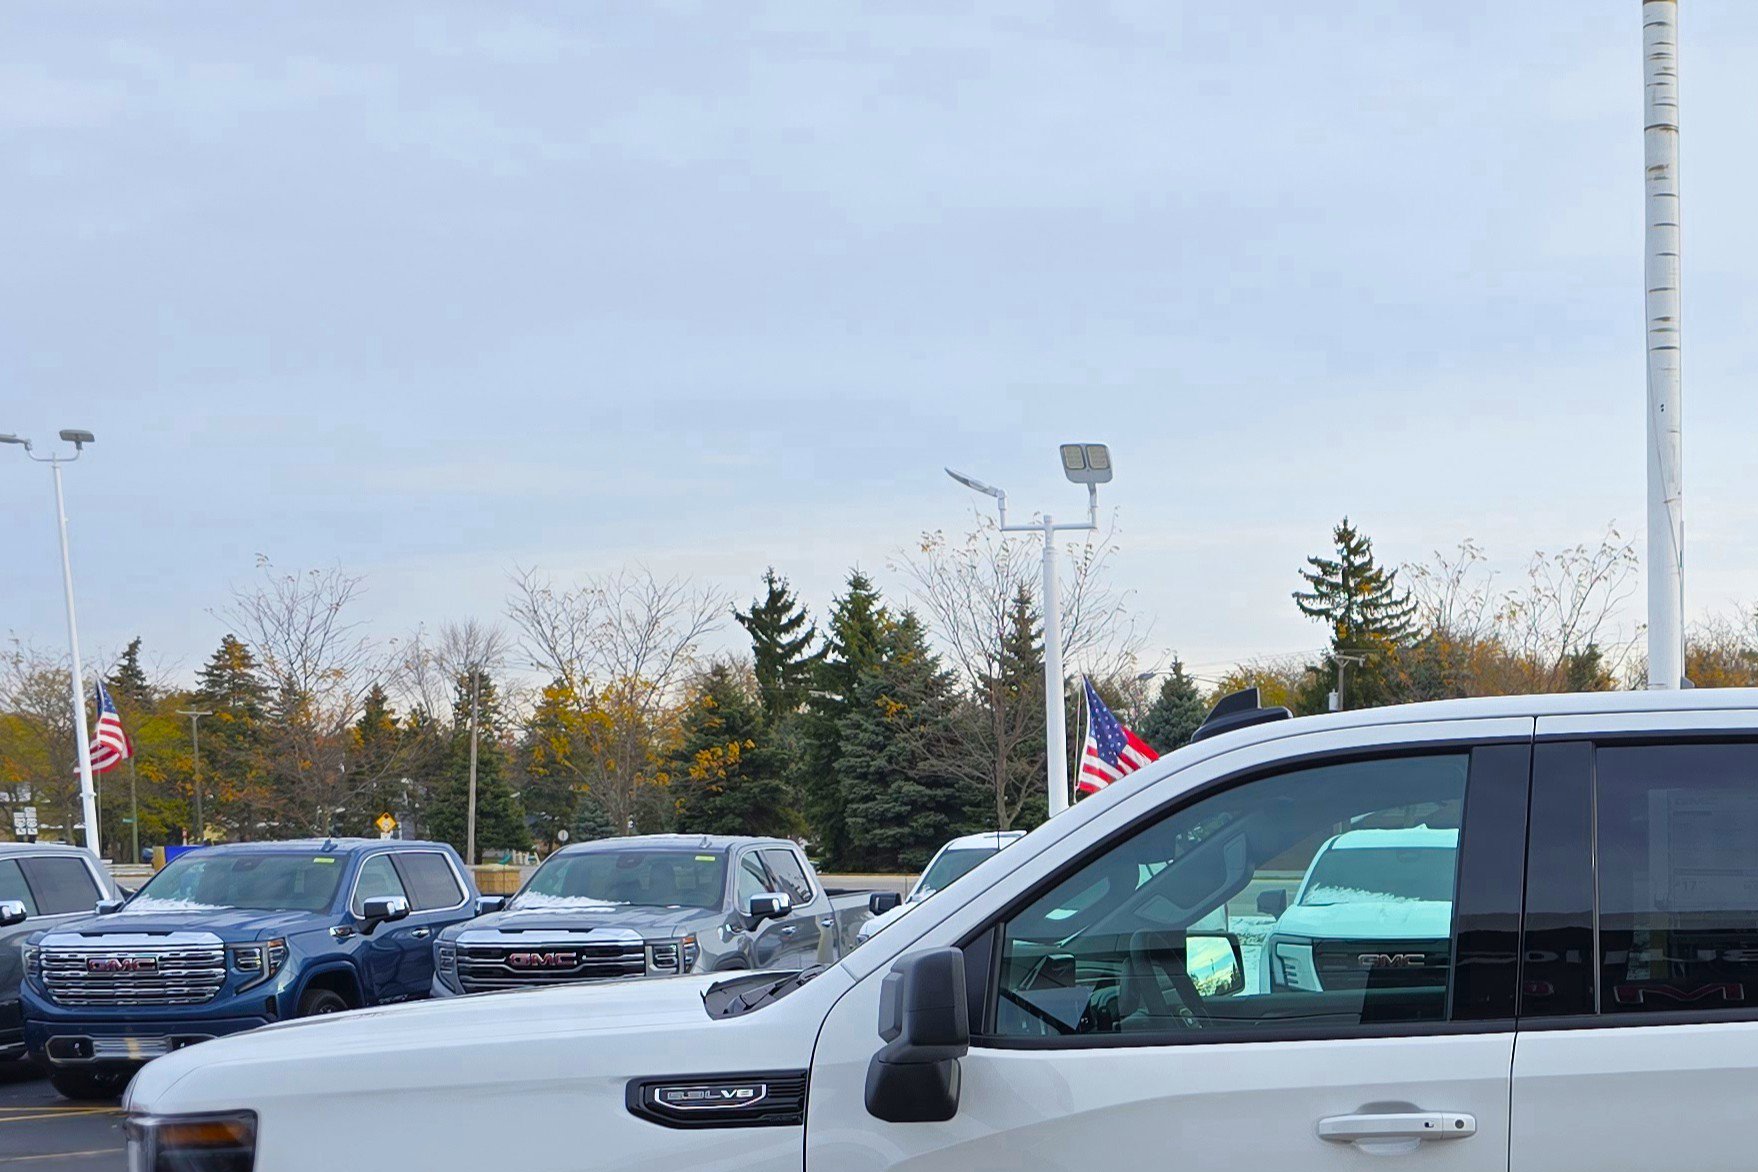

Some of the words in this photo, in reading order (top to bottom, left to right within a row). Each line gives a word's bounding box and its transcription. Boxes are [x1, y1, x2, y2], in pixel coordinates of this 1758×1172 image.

[88, 958, 156, 973] GMC
[509, 952, 578, 967] GMC
[1357, 953, 1426, 968] GMC
